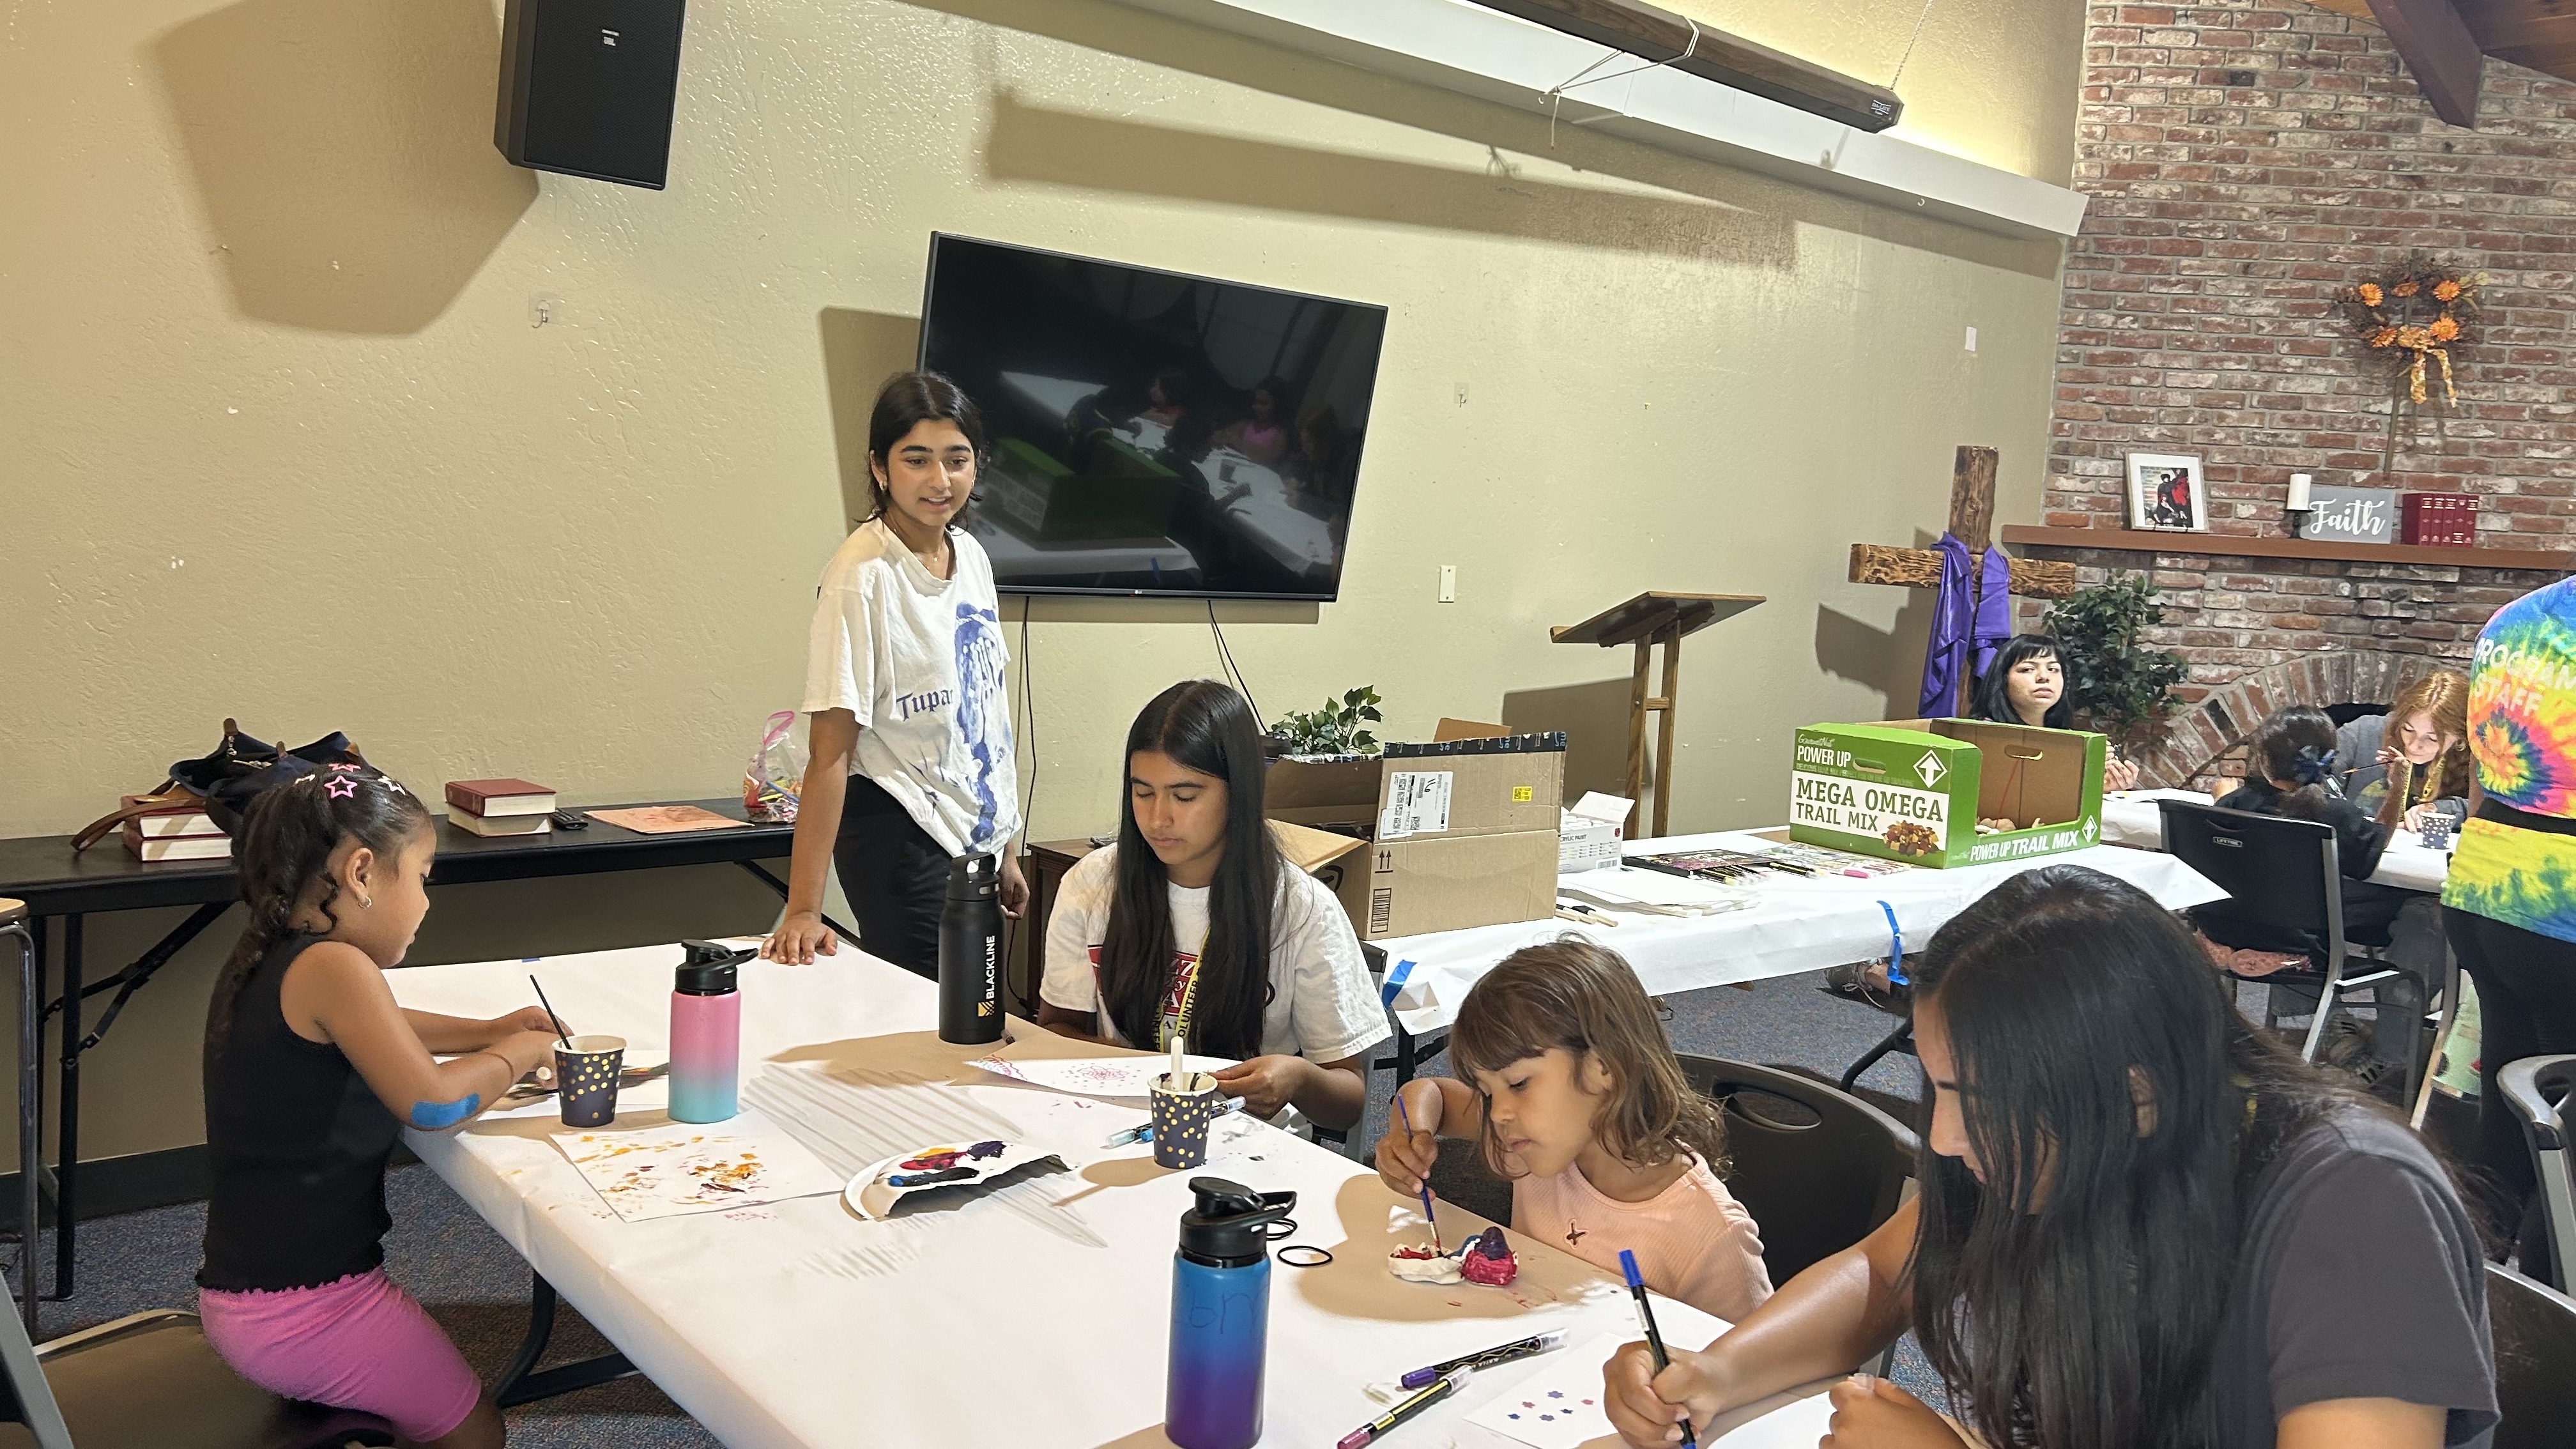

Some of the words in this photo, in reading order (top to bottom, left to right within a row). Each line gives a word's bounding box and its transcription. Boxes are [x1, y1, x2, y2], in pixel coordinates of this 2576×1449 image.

[2309, 498, 2386, 535] Faith
[2474, 673, 2543, 716] STAFF
[1797, 746, 1834, 765] POWER
[1836, 751, 1851, 768] UP
[1796, 778, 1856, 808] MEGA
[1865, 789, 1943, 822] OMEGA
[1796, 802, 1841, 825] TRAIL
[1848, 811, 1878, 832] MIX
[1970, 841, 1999, 862] POWER
[1999, 841, 2011, 857] UP
[2012, 834, 2050, 856] TRAIL
[2051, 830, 2080, 850] MIX
[986, 935, 995, 1000] BLACKLINE
[1177, 980, 1199, 1037] OLUNTEER
